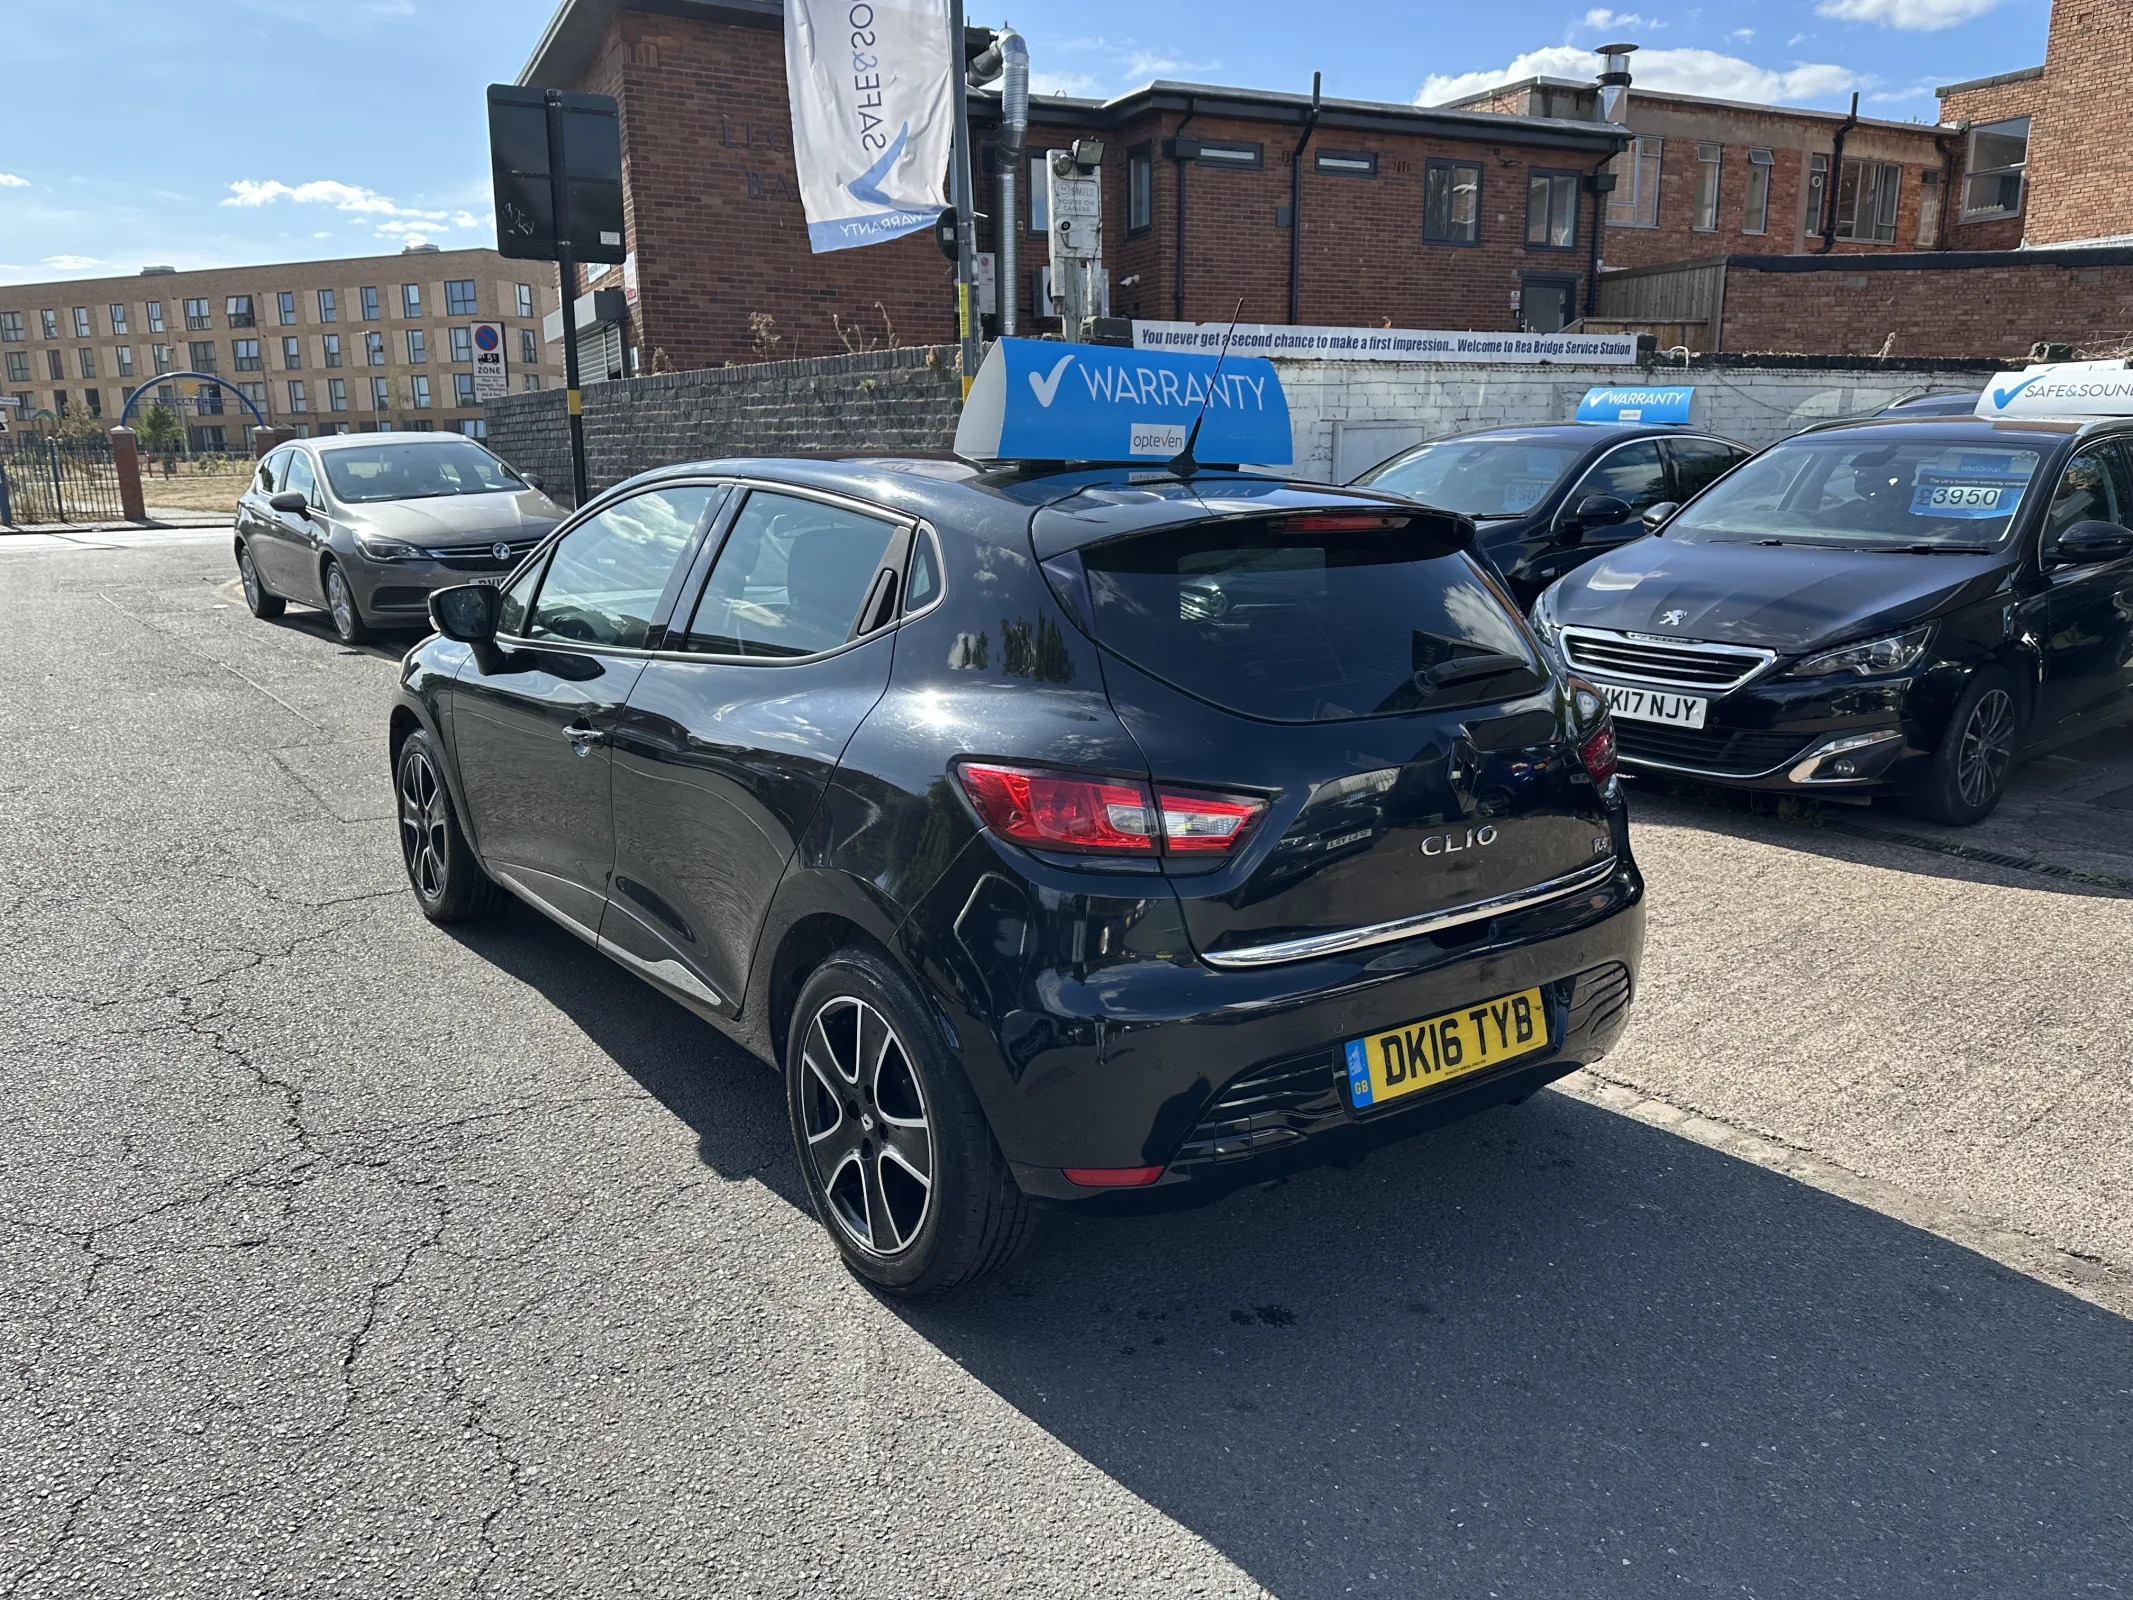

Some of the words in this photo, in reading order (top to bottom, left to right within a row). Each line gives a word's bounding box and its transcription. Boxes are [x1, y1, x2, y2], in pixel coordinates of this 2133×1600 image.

[722, 118, 793, 153] LLO
[746, 170, 796, 201] BA
[1071, 187, 1095, 197] SMILE
[1142, 329, 1163, 344] You
[1165, 332, 1199, 345] never
[1201, 332, 1220, 347] get
[1221, 335, 1230, 346] a
[1231, 333, 1273, 347] second
[1274, 334, 1314, 348] chance
[1316, 336, 1328, 349] to
[1329, 335, 1359, 350] make
[1360, 338, 1367, 350] a
[1369, 336, 1391, 350] first
[1457, 338, 1502, 353] Welcome
[1504, 340, 1513, 353] to
[1515, 340, 1532, 354] Rea
[1534, 341, 1563, 355] Bridge
[1565, 341, 1599, 354] Service
[1600, 342, 1631, 355] Station
[477, 366, 501, 374] ZONE
[1078, 363, 1265, 411] WARRANTY
[1608, 392, 1686, 405] WARRANTY
[1133, 429, 1183, 450] opteven
[1961, 465, 2001, 473] WMSGroup
[1649, 694, 1697, 721] NJY
[1420, 825, 1498, 856] CLIO
[1380, 1018, 1463, 1087] DK16
[1468, 996, 1533, 1056] TYB
[1354, 1079, 1369, 1095] GB
